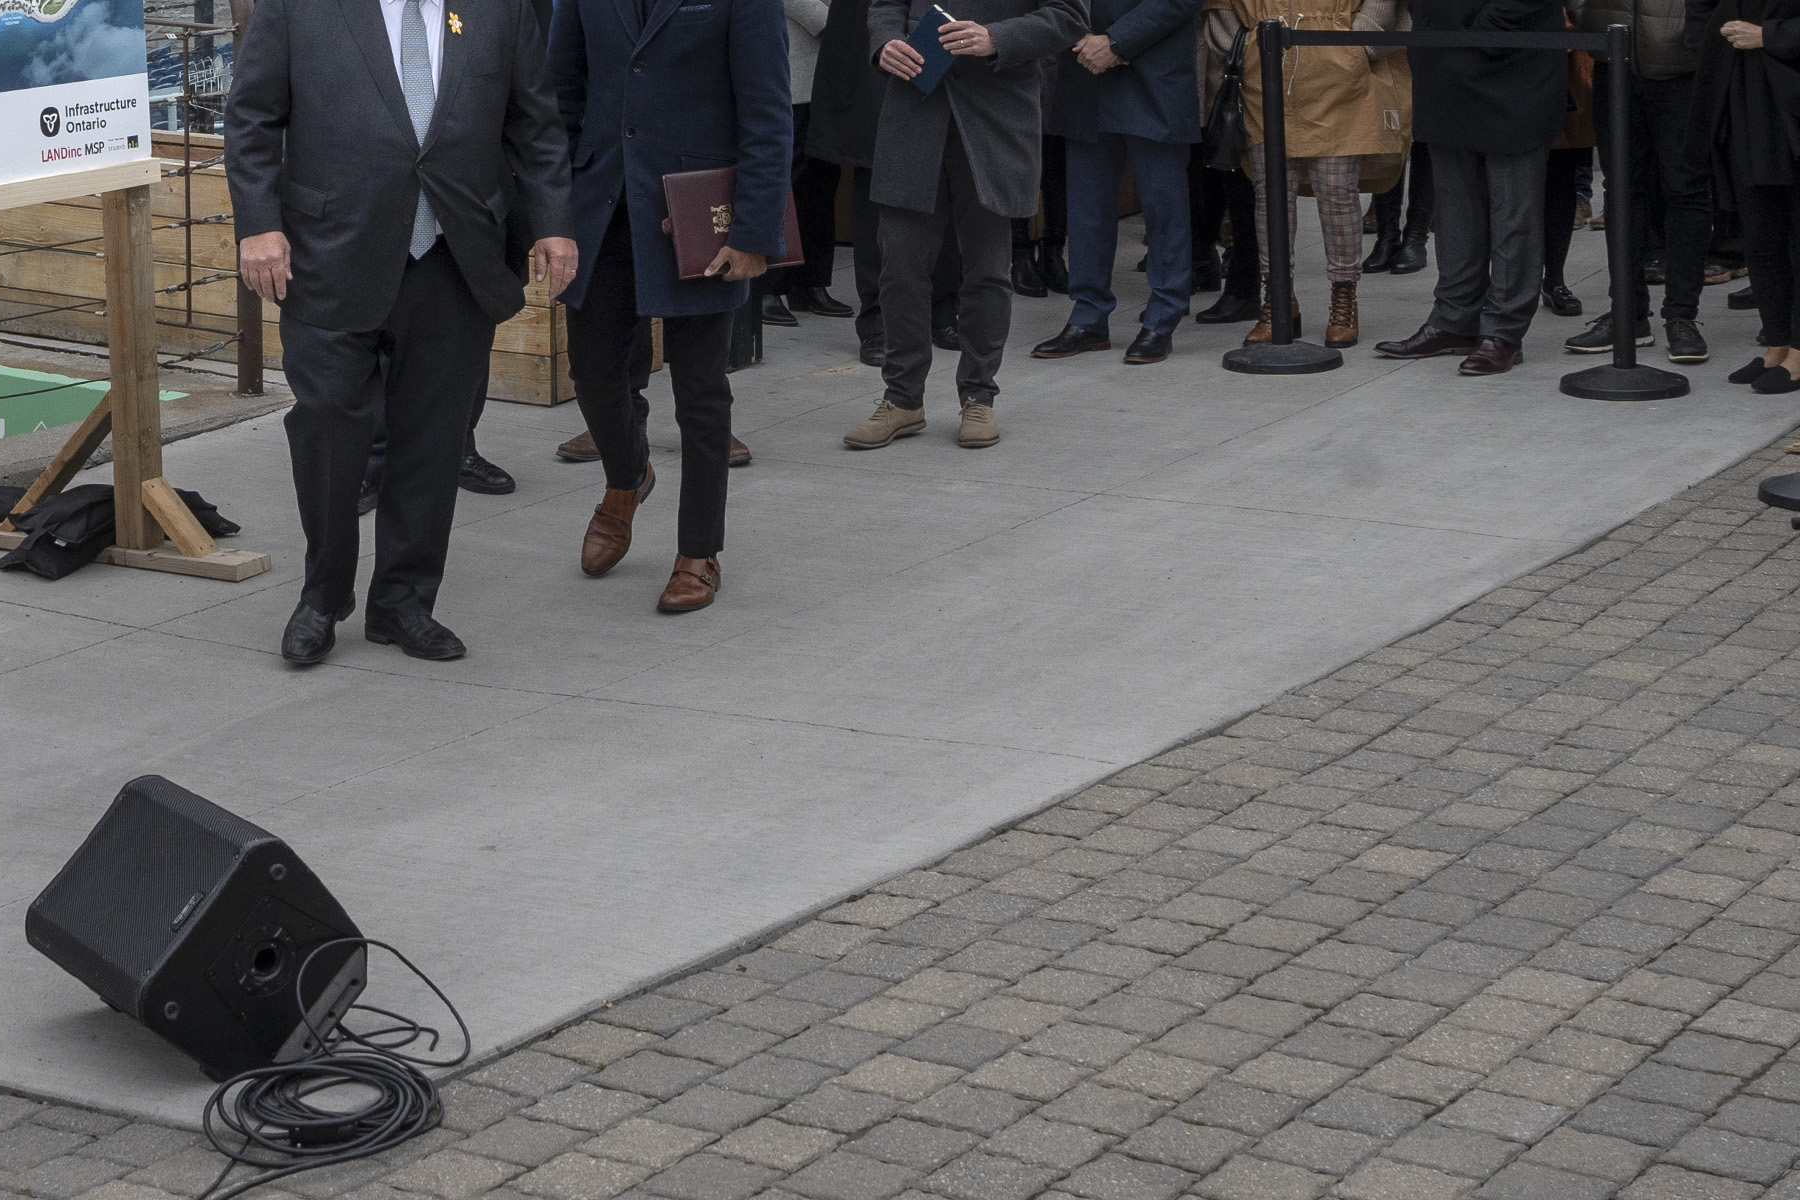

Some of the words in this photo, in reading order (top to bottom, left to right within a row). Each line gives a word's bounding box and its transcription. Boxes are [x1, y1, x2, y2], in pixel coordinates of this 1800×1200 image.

[65, 98, 137, 118] Infrastructure
[66, 117, 107, 133] Ontario
[41, 146, 82, 163] LANDinc
[84, 141, 105, 156] MSP
